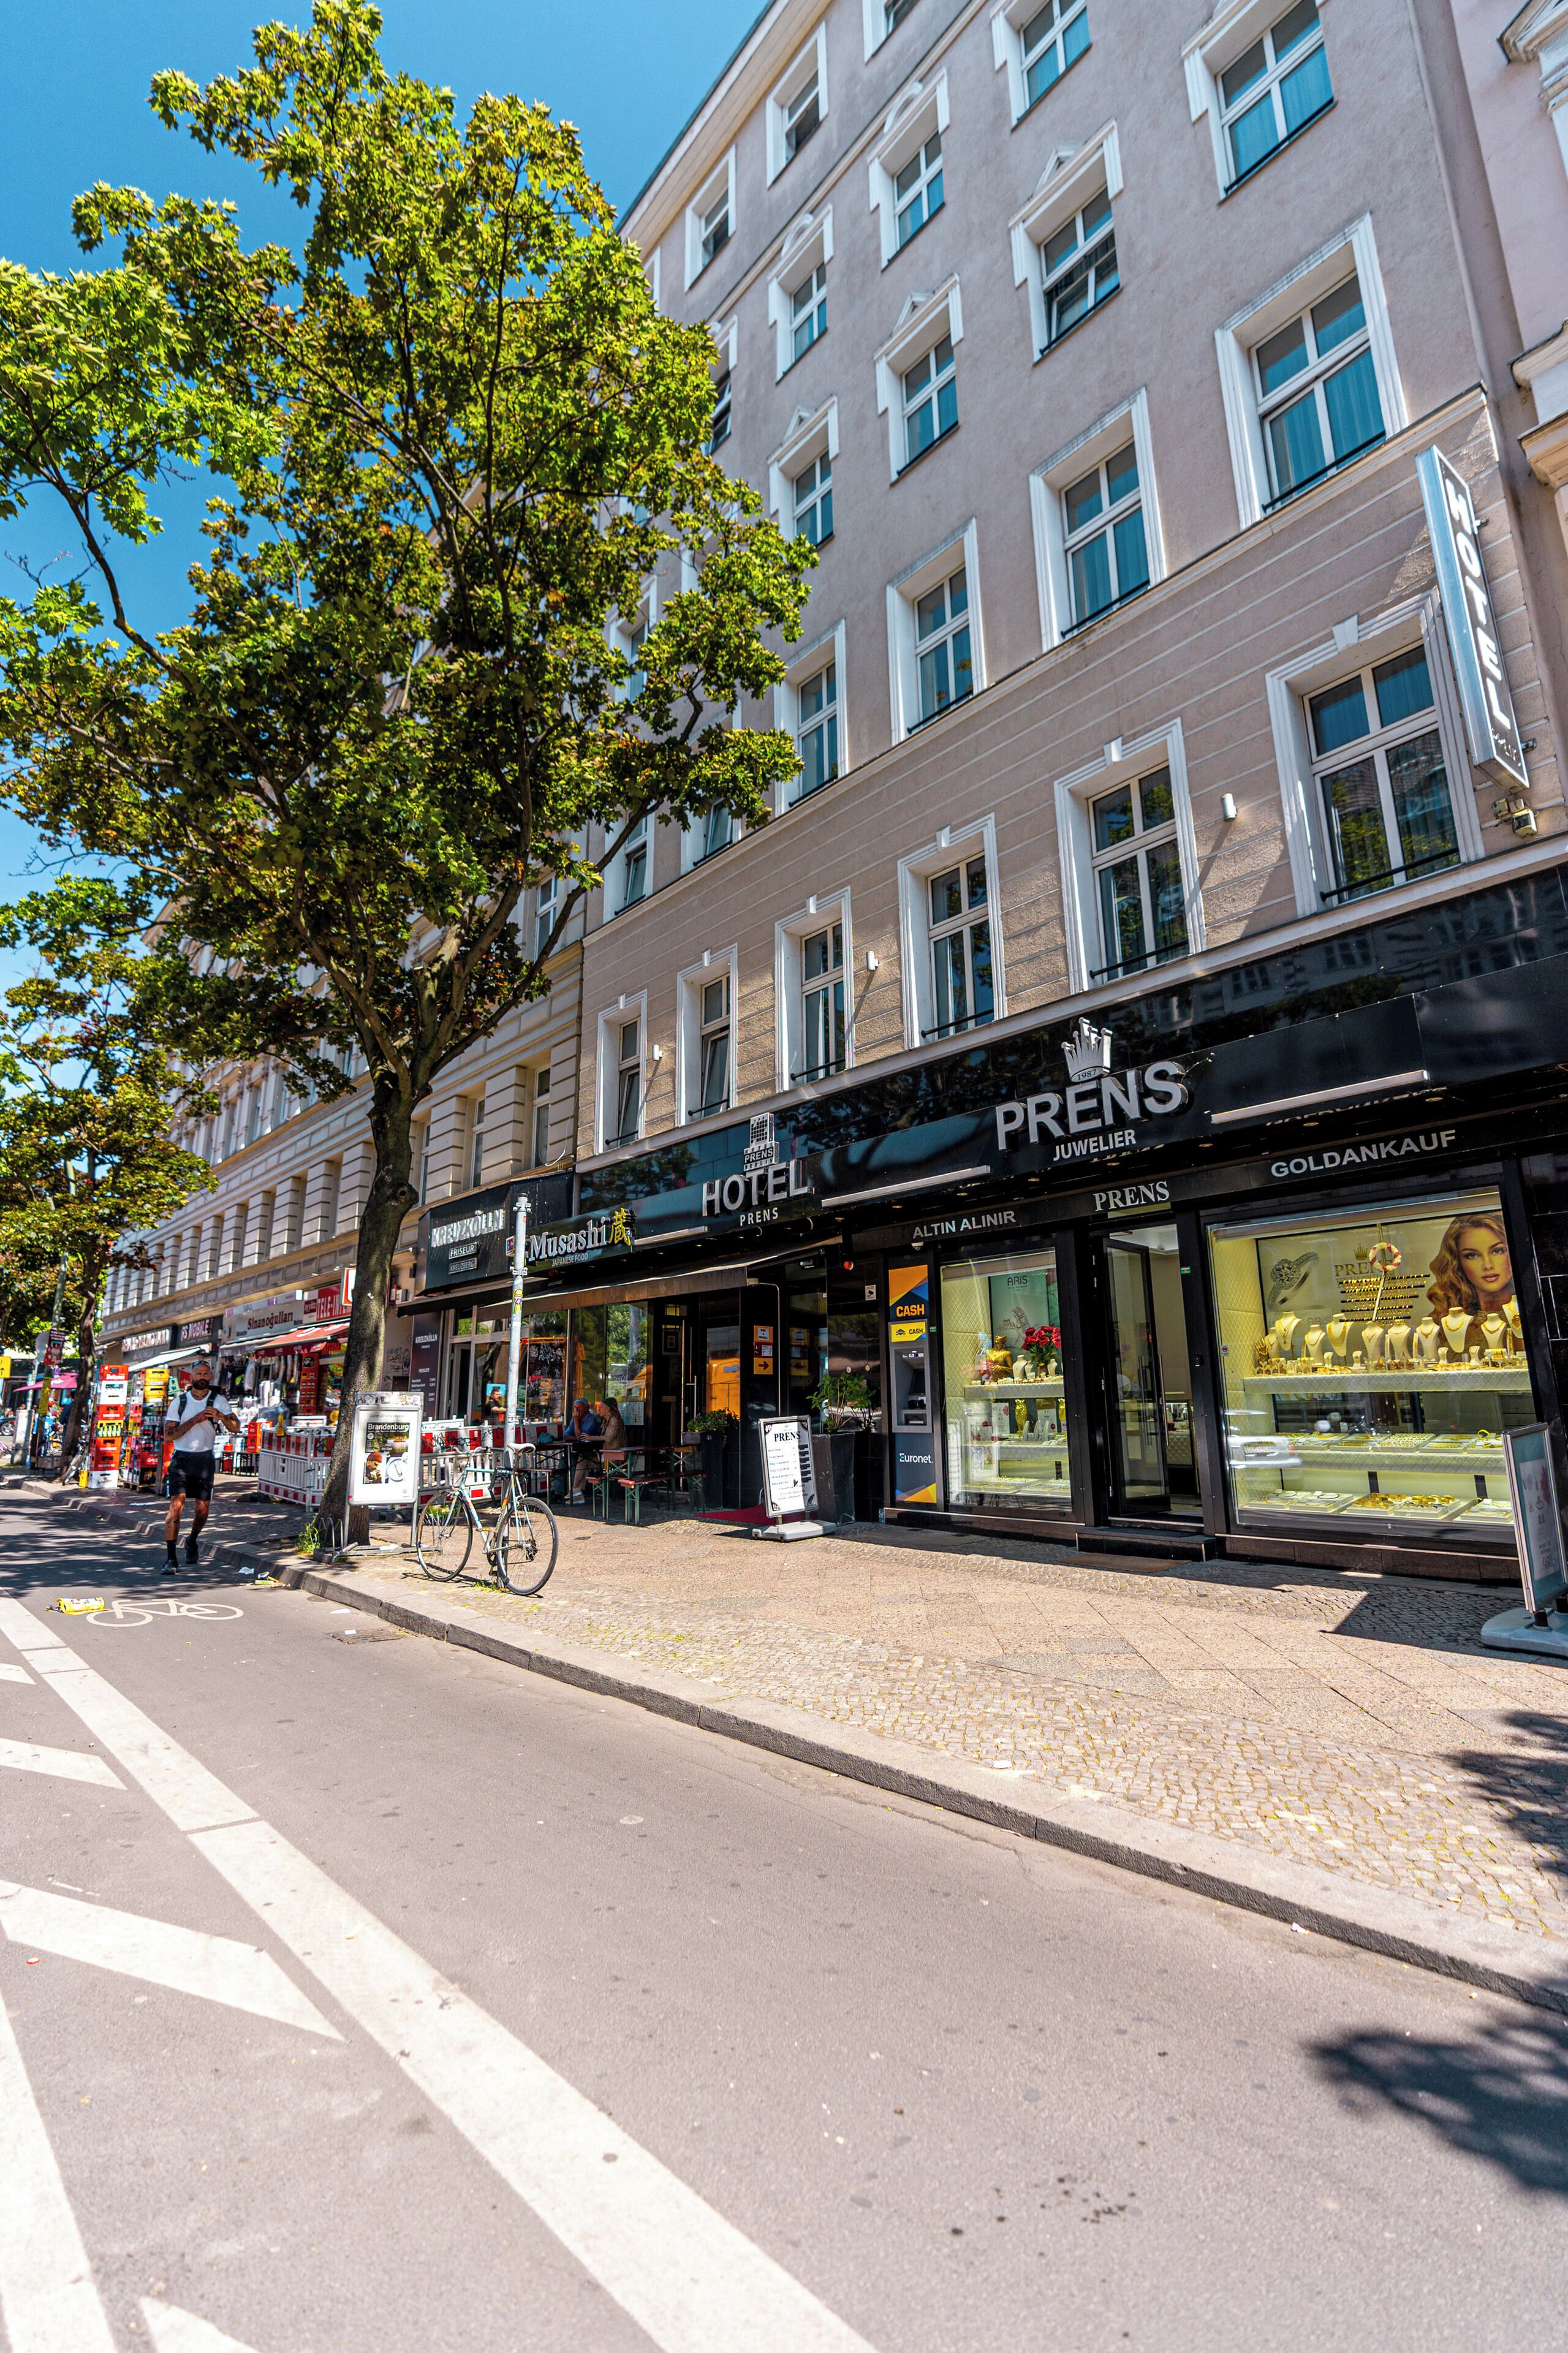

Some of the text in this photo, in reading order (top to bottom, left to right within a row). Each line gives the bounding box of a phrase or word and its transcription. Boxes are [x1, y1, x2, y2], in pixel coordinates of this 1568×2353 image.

[1445, 478, 1511, 730] HOTEL
[1077, 1069, 1097, 1080] 1987
[995, 1061, 1184, 1151] PRENS
[1053, 1129, 1136, 1162] JUWELIER
[1270, 1129, 1456, 1177] GOLDANKAUF
[744, 1148, 773, 1164] PRENS
[702, 1158, 810, 1216] HOTEL
[1093, 1180, 1170, 1211] PRENS
[740, 1207, 778, 1226] PRENS
[912, 1210, 1017, 1239] ALTIN ALINIR
[430, 1208, 505, 1248] KREUZKÖLLN
[528, 1216, 607, 1262] Musashi
[450, 1245, 475, 1257] FRISEUR
[551, 1252, 589, 1267] JAPANESE FOOD
[449, 1260, 475, 1272] KREUZBERG
[1334, 1259, 1396, 1277] PRE
[896, 1303, 925, 1317] CASH
[368, 1423, 409, 1432] Brandenburg
[774, 1431, 801, 1442] PRENS
